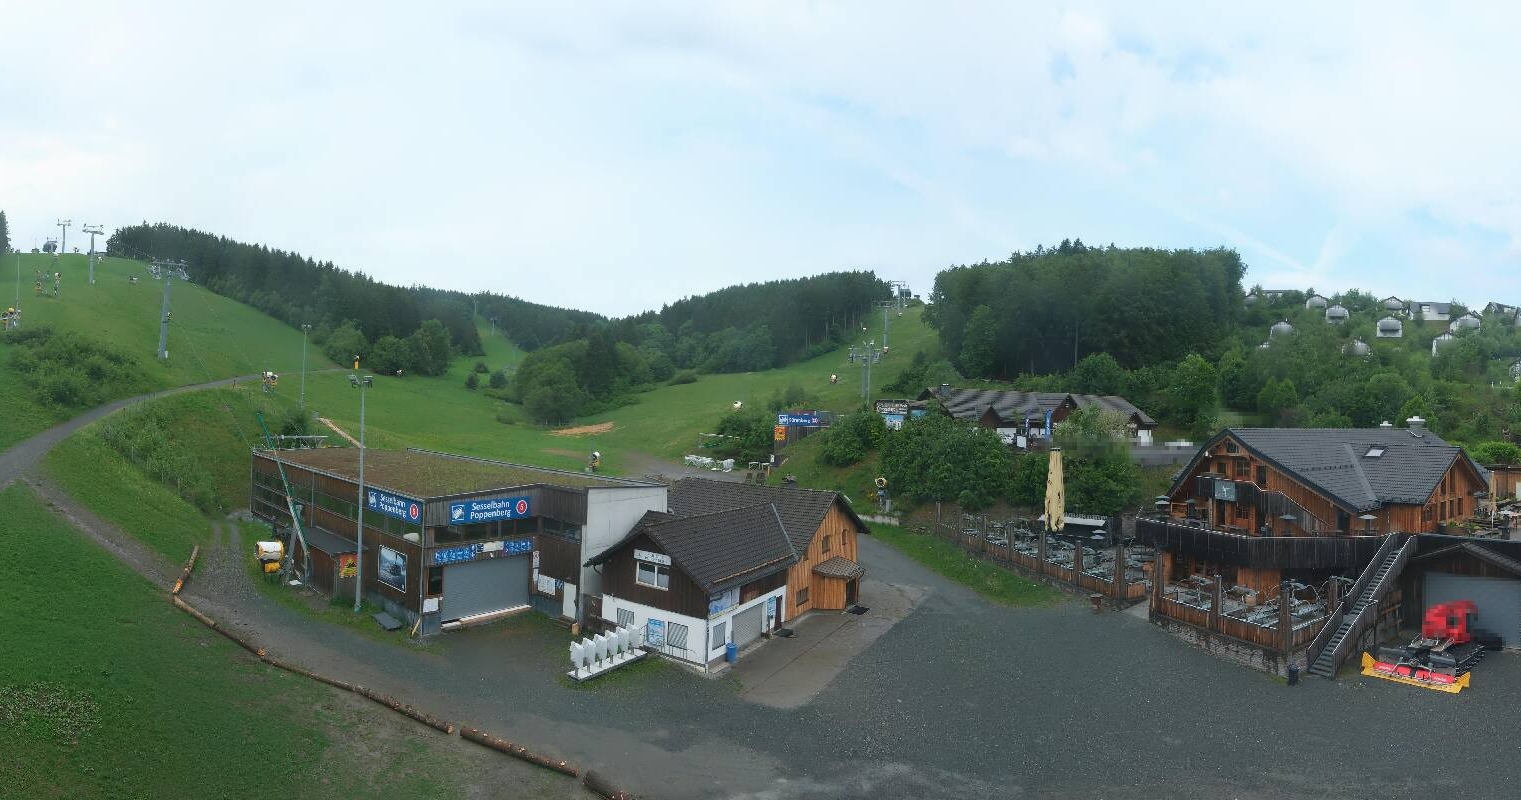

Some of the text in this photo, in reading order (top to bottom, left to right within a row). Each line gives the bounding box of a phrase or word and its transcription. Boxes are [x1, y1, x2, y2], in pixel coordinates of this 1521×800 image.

[380, 493, 406, 508] Sesselbahn
[472, 500, 510, 511] Sesselbahn
[379, 501, 407, 519] Poppenberg
[470, 509, 511, 520] Poppenberg
